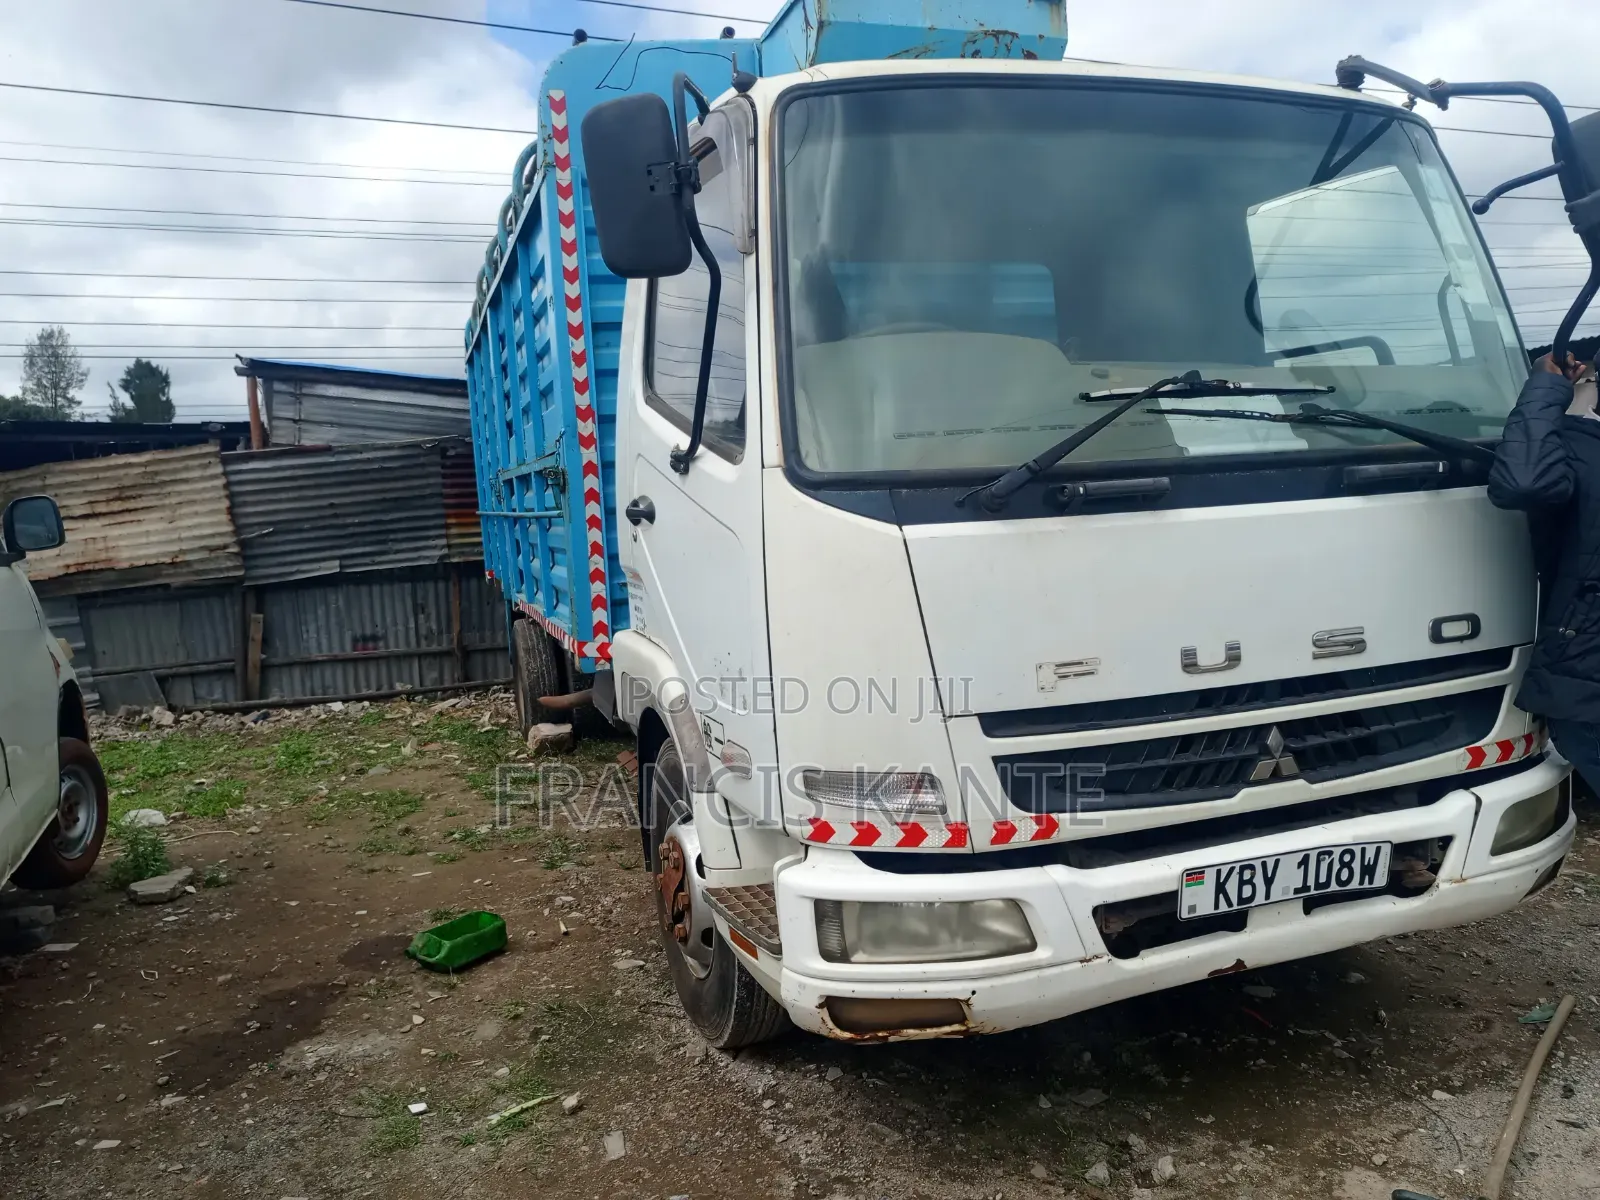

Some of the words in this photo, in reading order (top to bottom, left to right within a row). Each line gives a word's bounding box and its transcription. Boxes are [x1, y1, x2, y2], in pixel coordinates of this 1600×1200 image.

[1036, 613, 1481, 692] FUSO
[1214, 858, 1280, 911] KBY
[1293, 846, 1382, 895] 108W
